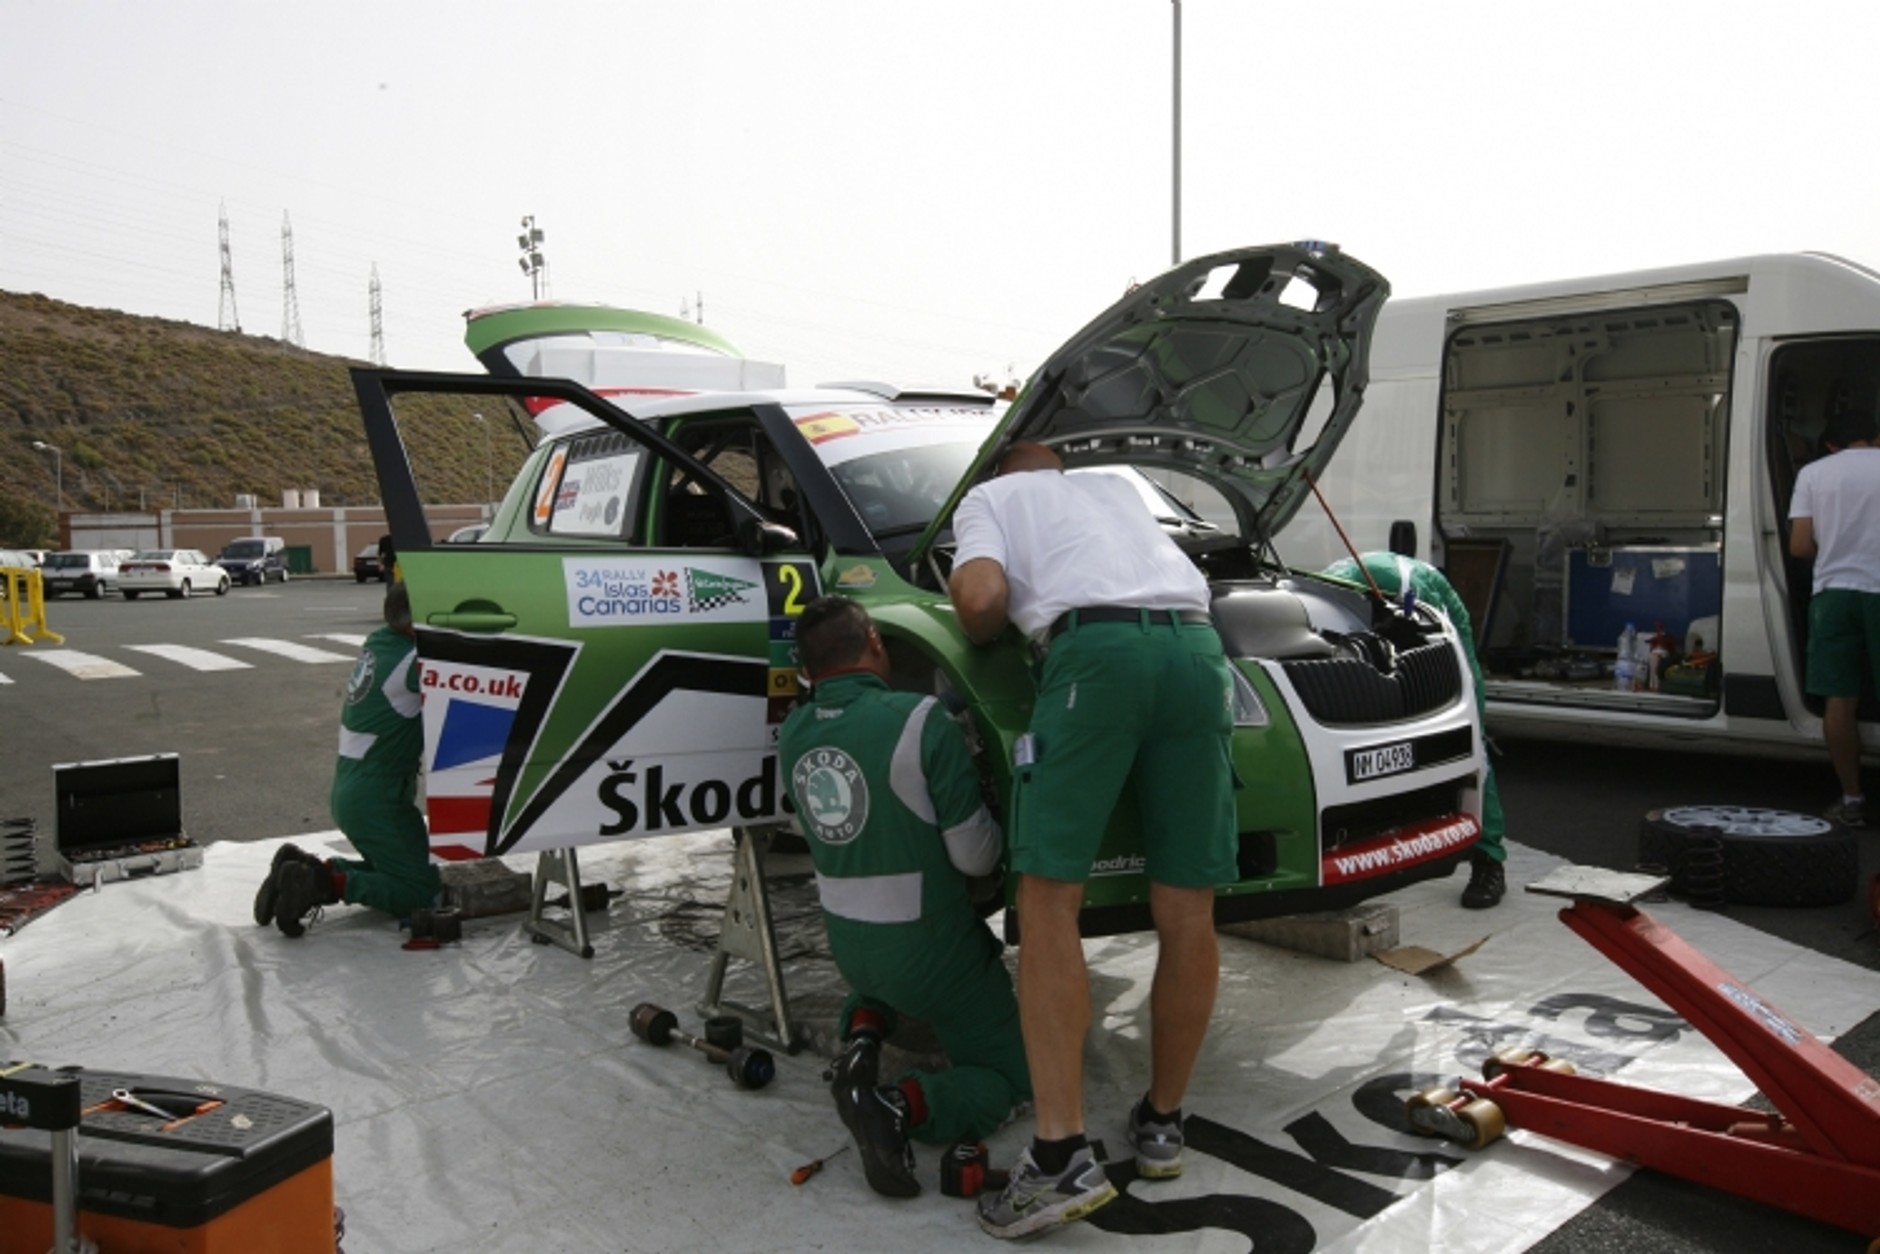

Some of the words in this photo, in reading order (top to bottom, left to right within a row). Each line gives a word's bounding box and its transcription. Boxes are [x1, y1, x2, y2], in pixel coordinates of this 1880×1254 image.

[576, 569, 602, 588] 34
[602, 569, 646, 580] RALLY
[604, 582, 649, 598] Islas
[778, 563, 806, 617] 2
[578, 596, 681, 616] Canarias
